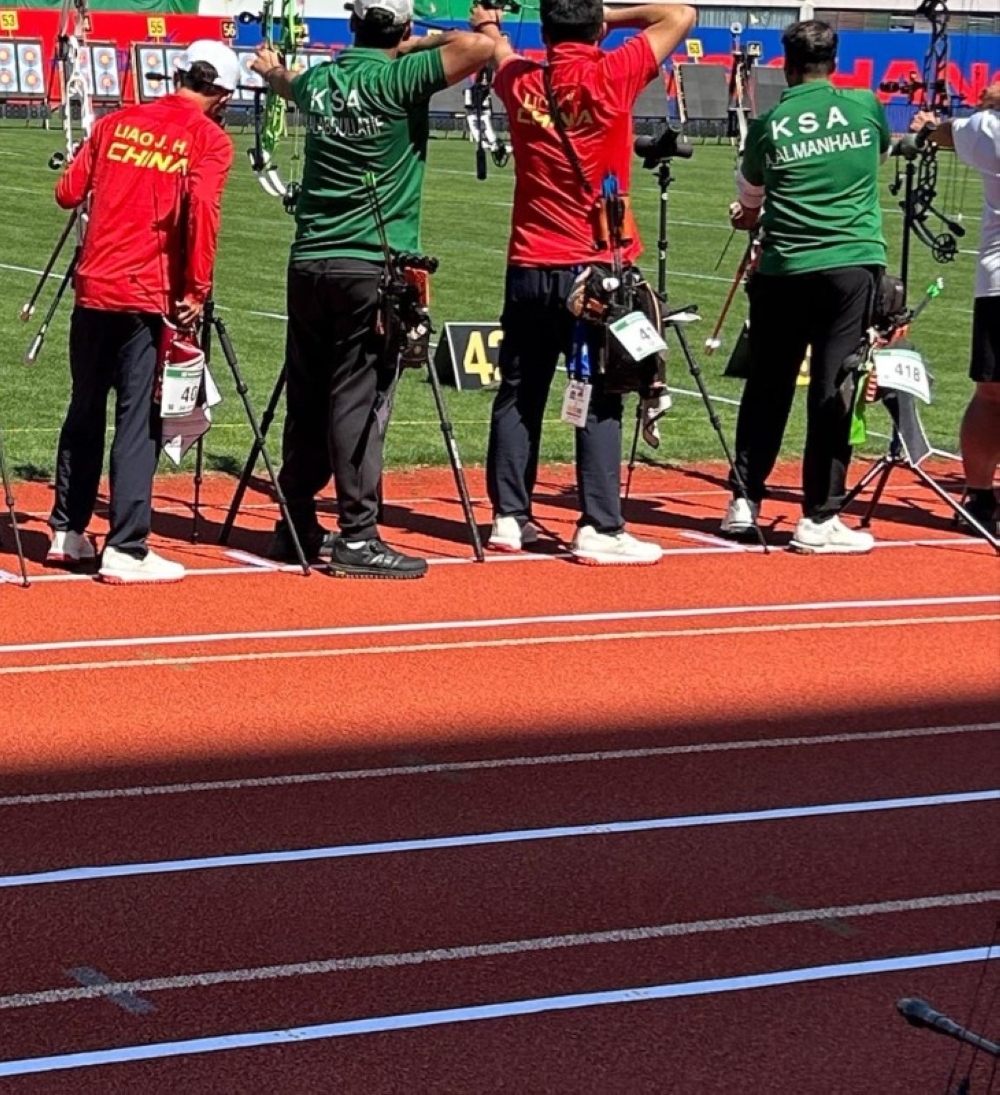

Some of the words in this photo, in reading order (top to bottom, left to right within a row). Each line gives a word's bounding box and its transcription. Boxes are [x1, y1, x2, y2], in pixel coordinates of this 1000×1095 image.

[1, 14, 15, 27] 53
[150, 21, 163, 34] 55
[223, 23, 236, 37] 56
[114, 123, 154, 146] LIAO
[106, 142, 188, 176] CHINA
